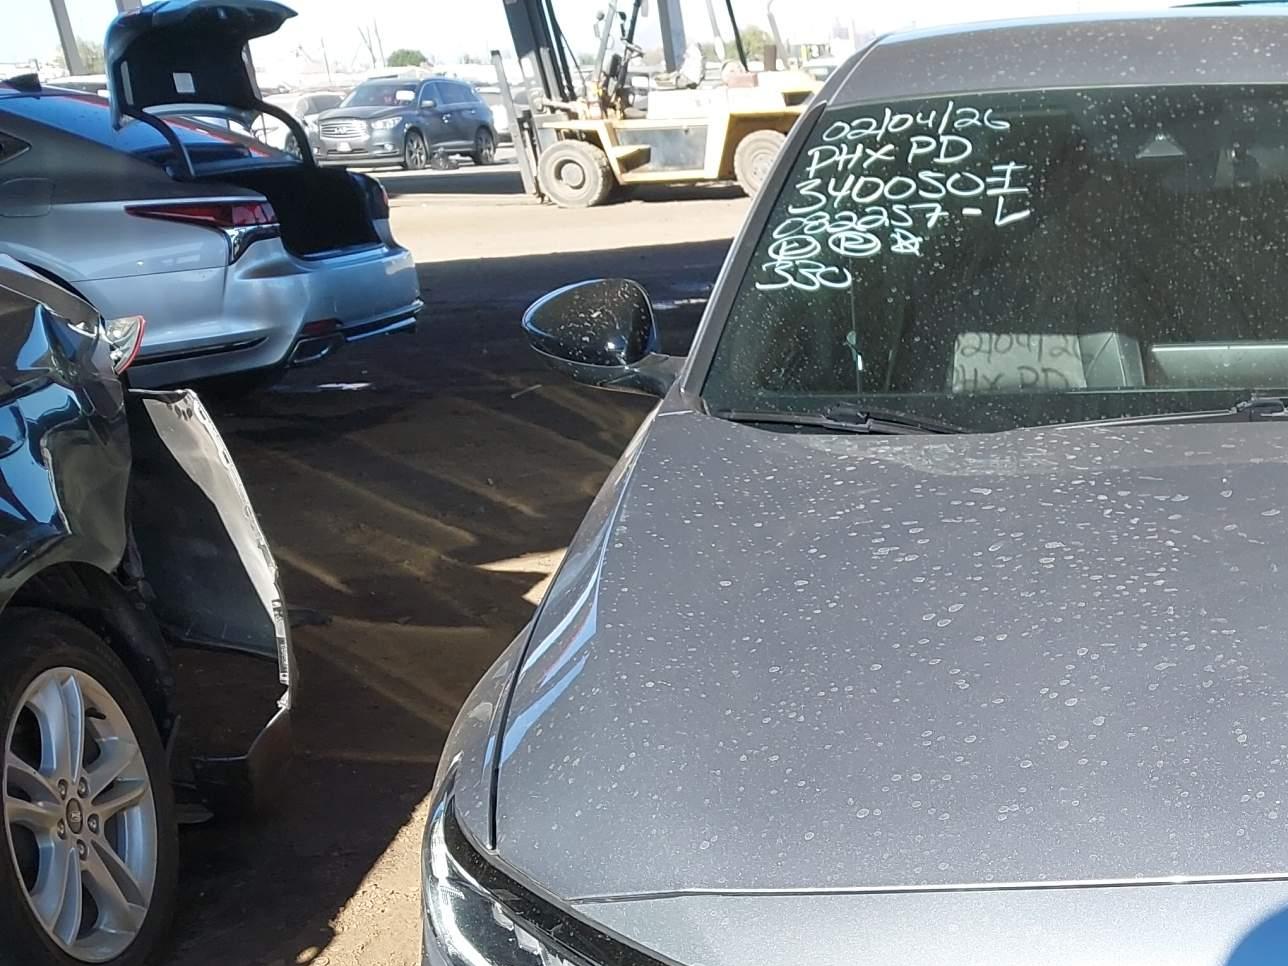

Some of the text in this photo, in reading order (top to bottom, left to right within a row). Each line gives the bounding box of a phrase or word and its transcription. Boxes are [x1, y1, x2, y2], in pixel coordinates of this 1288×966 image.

[823, 101, 1011, 142] 02/04/26
[806, 135, 973, 178] PHX PD
